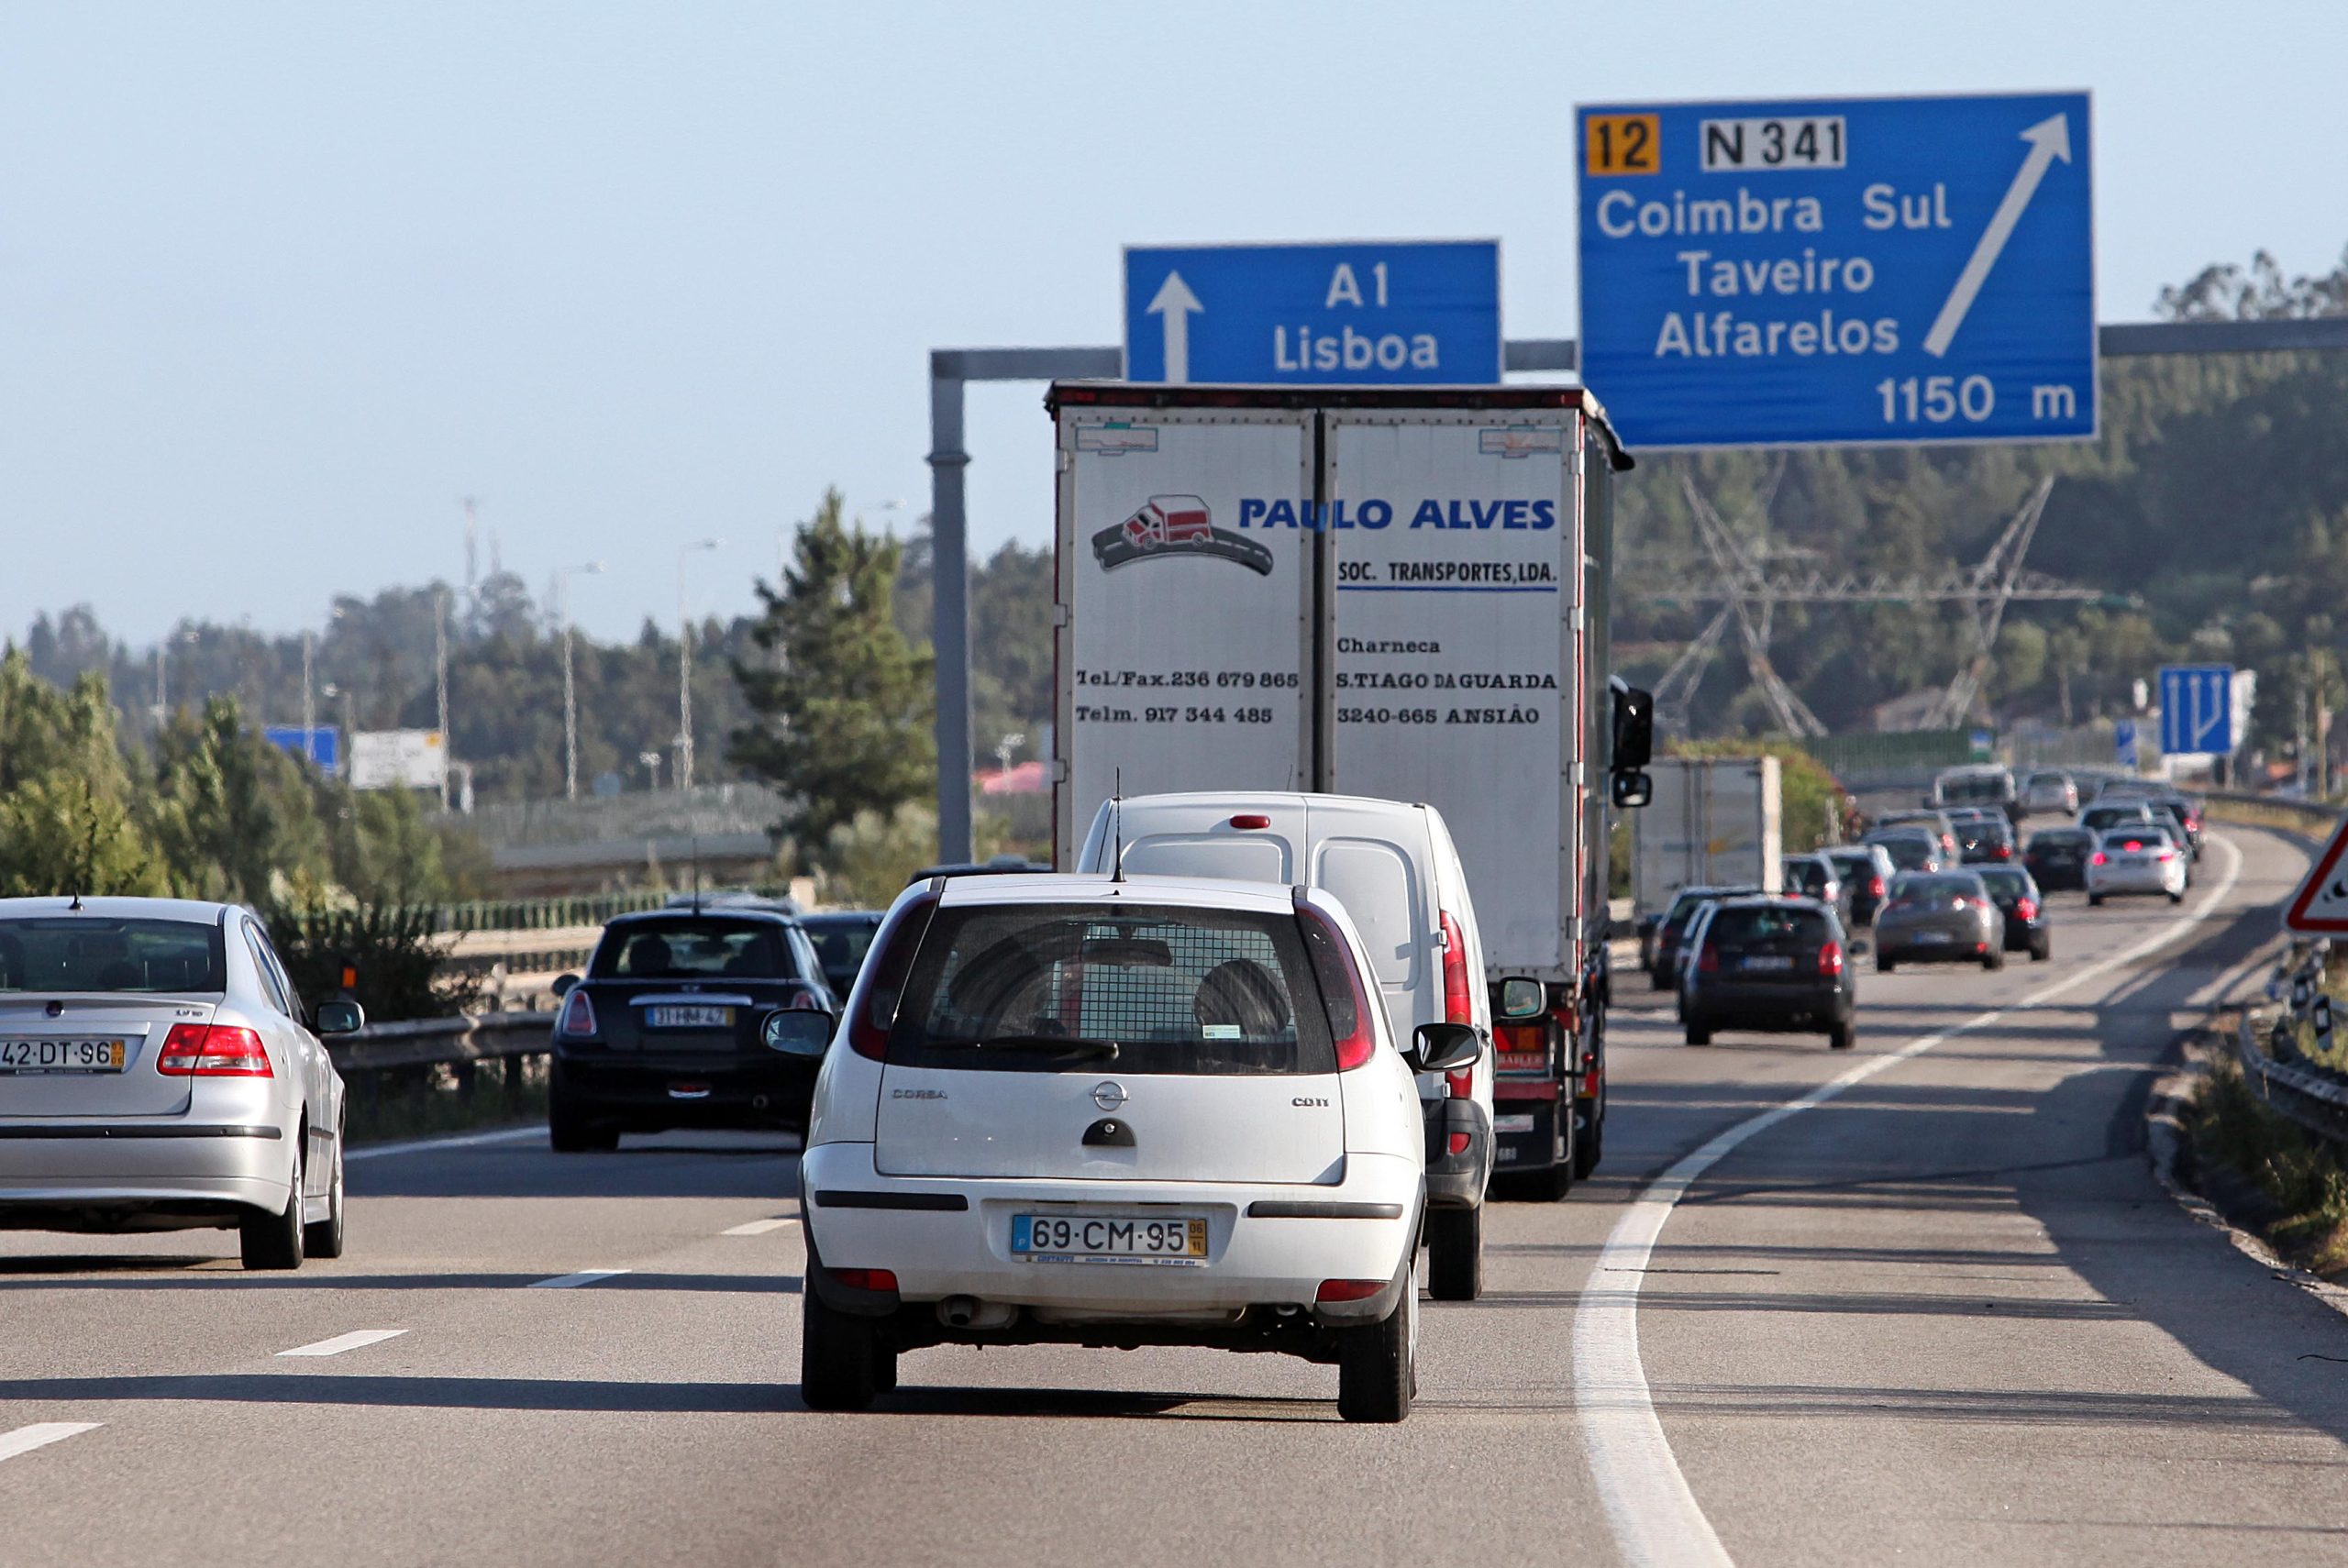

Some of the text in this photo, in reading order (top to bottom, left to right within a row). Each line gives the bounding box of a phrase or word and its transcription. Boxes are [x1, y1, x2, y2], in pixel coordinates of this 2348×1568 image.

[1597, 119, 1649, 169] 12
[1707, 121, 1844, 166] N 341
[1597, 183, 1952, 237] Coimbra Sul
[1678, 248, 1875, 296] Taveiro
[1655, 310, 1899, 358] Alfarelos
[1274, 326, 1439, 371] Lisboa
[1877, 375, 2076, 423] 1150 m
[1239, 499, 1556, 533] PAULO ALVES
[1338, 562, 1378, 581] SOC.
[1337, 637, 1440, 653] Charneca
[1217, 672, 1255, 688] 679
[1259, 672, 1299, 688] 865
[1336, 673, 1428, 689] S.TIAGO
[1459, 674, 1557, 689] GUARDA
[1076, 706, 1273, 723] Telm. 917 344 485
[1337, 703, 1539, 723] 3240-665 ANSIÃO
[893, 1088, 948, 1099] CORSA
[1190, 1222, 1203, 1233] 06
